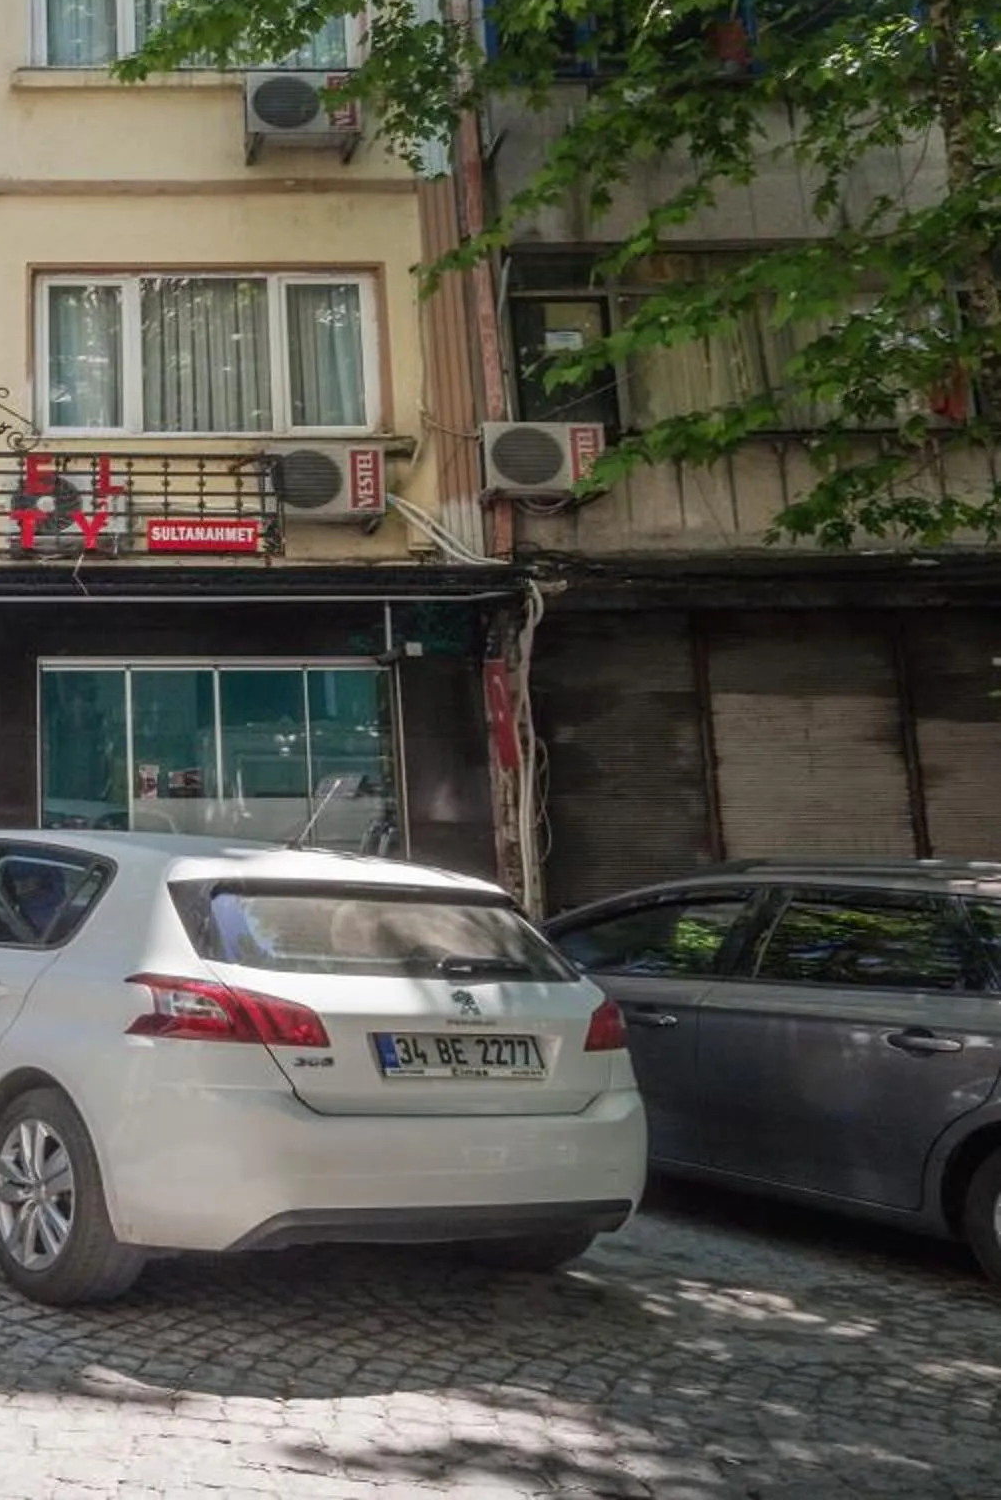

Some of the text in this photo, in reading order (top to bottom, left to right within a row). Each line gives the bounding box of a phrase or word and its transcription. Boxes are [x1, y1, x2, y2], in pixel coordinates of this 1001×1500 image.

[356, 450, 375, 508] VESTEL
[150, 526, 256, 543] SULTANAHMET
[396, 1037, 531, 1067] 34 BE 2277
